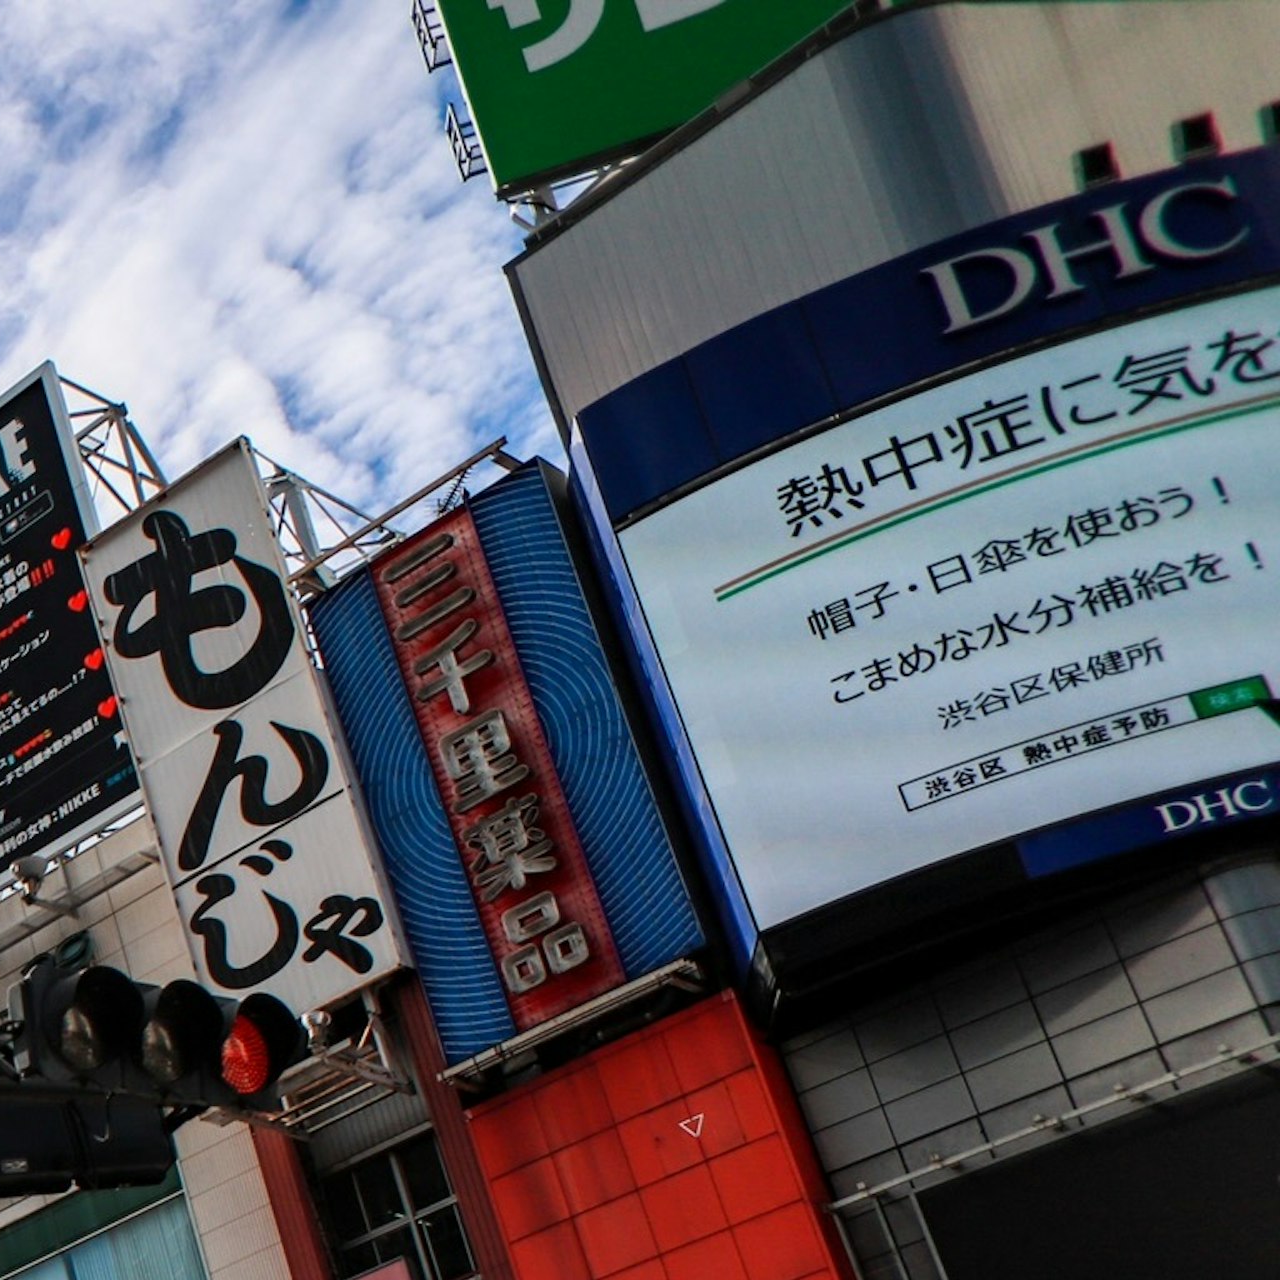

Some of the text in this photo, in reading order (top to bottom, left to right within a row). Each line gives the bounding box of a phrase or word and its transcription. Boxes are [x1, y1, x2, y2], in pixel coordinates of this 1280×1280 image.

[920, 176, 1251, 340] DHC
[808, 475, 1233, 641] 帽子・日傘を使おう！
[830, 540, 1265, 706] こまめな水分補給を！
[103, 508, 384, 989] もんじゃ
[380, 532, 590, 995] 三千里薬品
[925, 707, 1171, 800] 渋谷区 熱中症予防
[938, 637, 1166, 730] 渋谷区保健所
[1155, 780, 1274, 833] DHC
